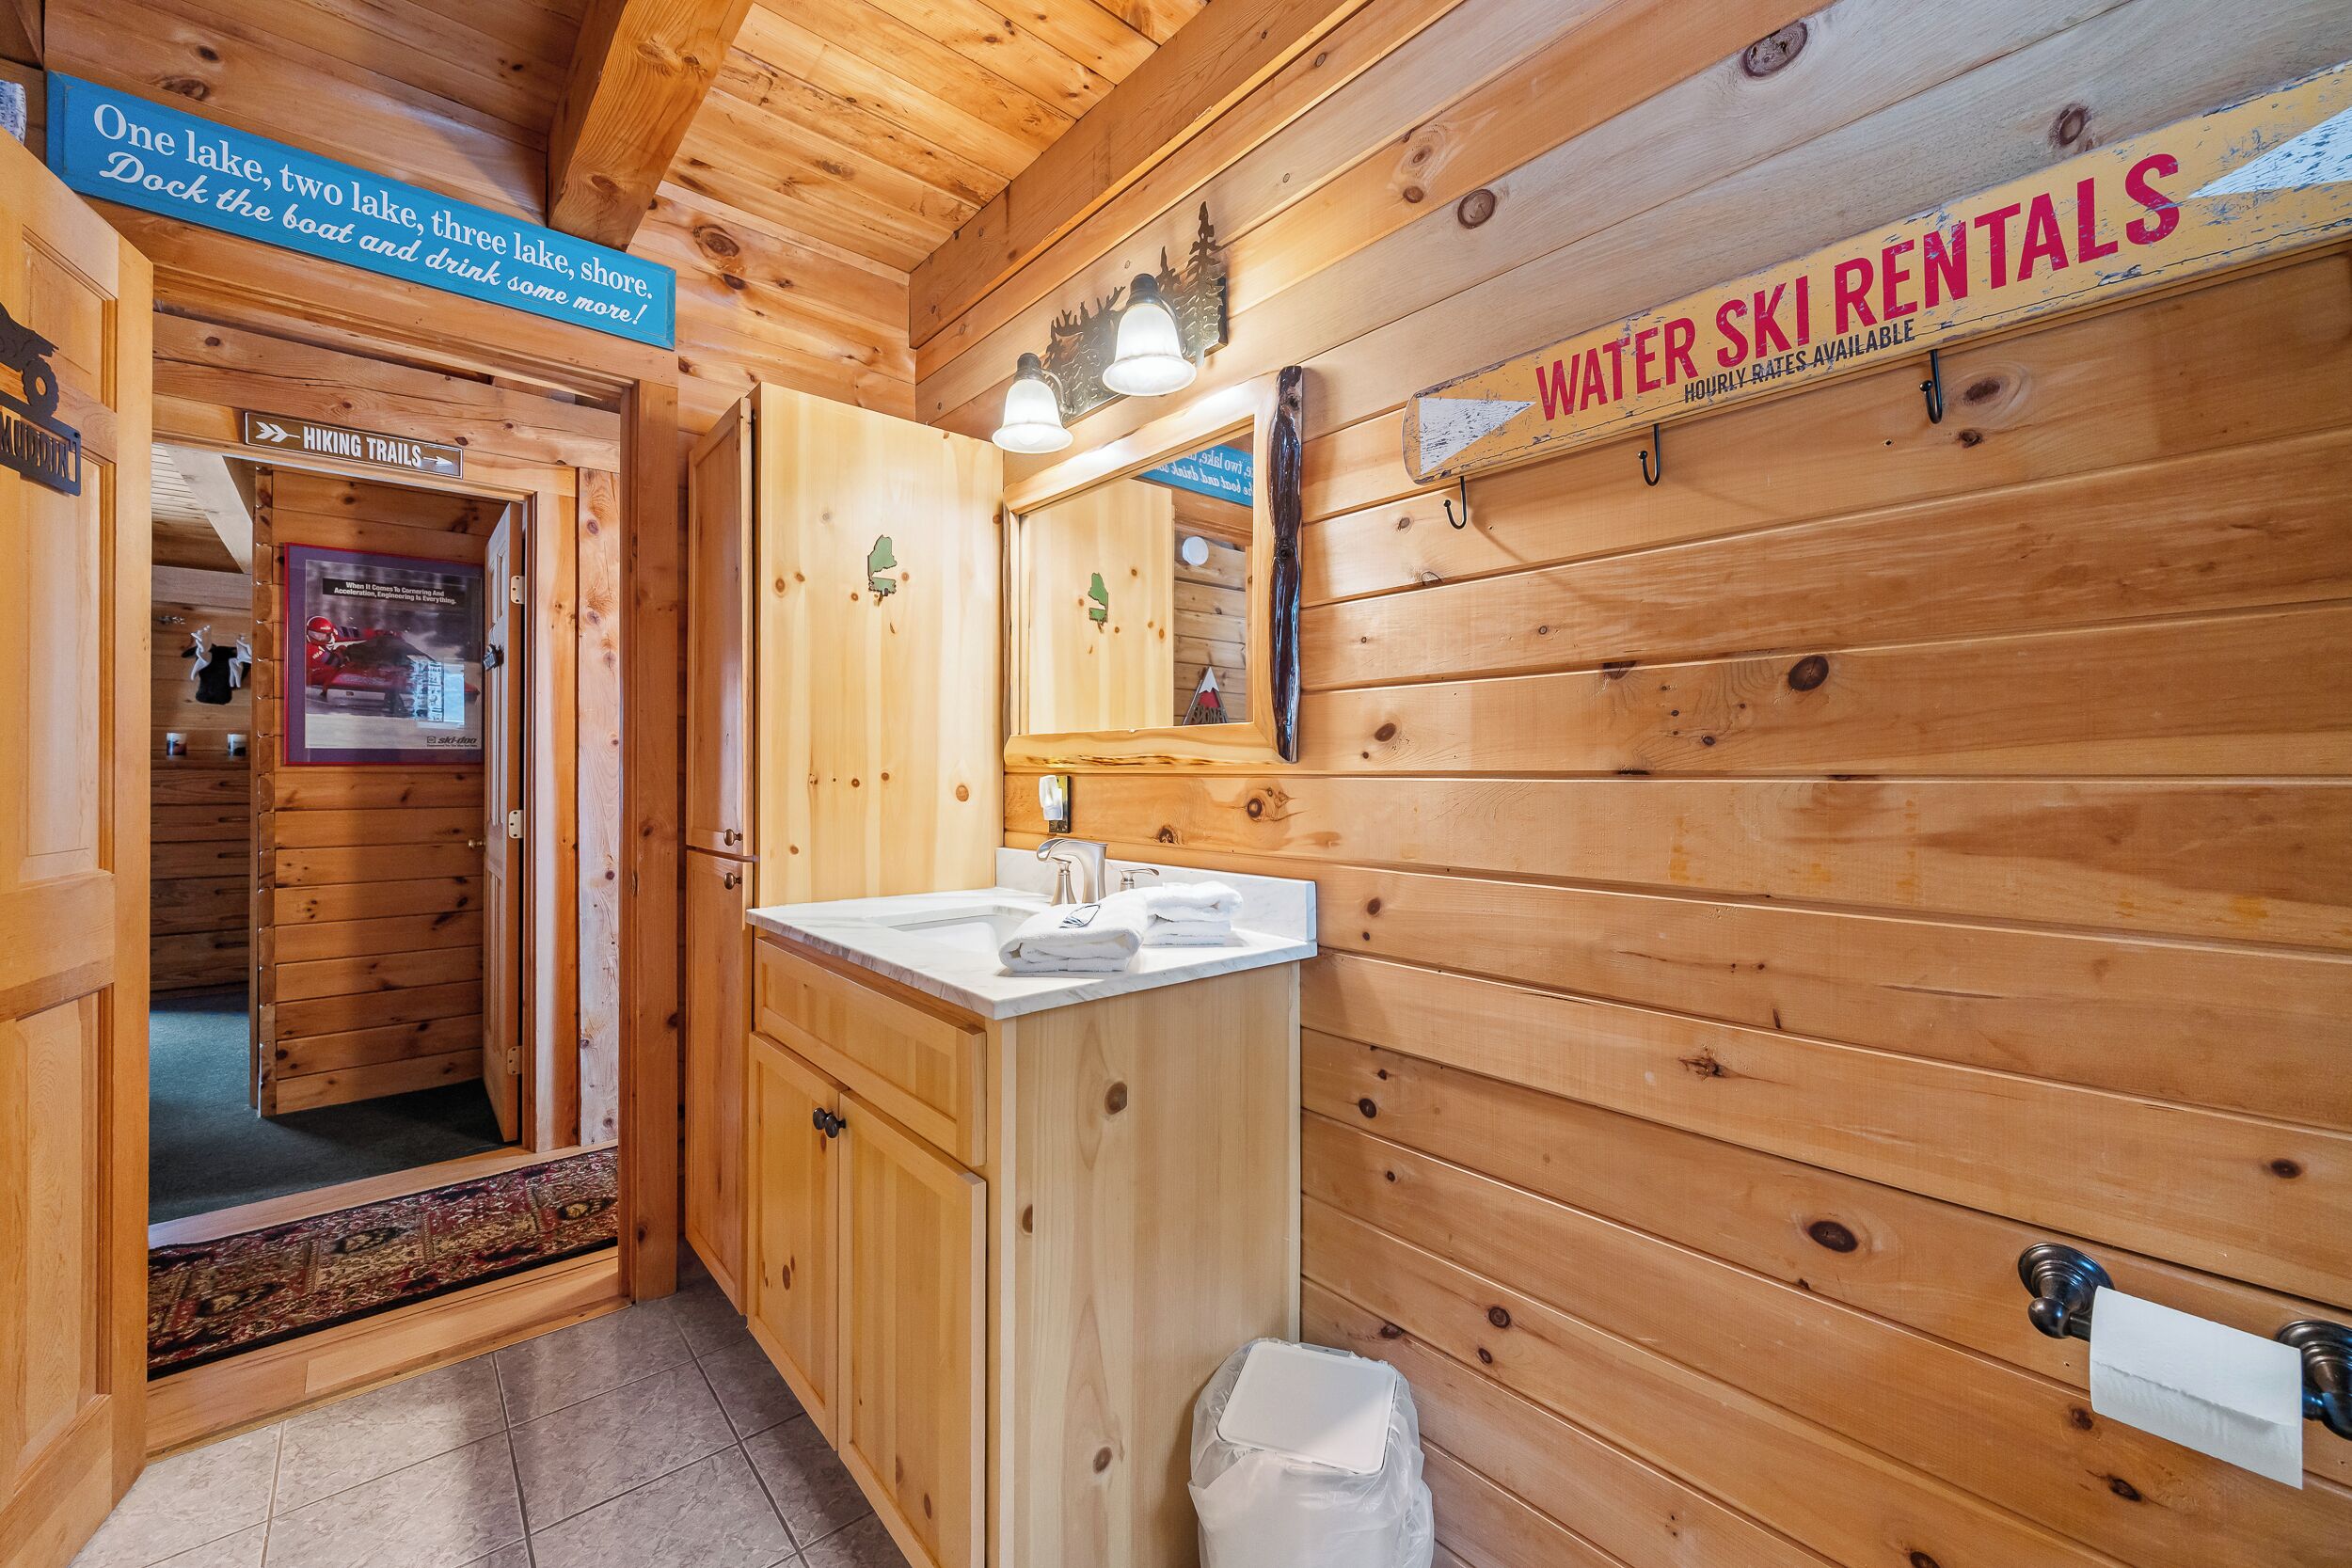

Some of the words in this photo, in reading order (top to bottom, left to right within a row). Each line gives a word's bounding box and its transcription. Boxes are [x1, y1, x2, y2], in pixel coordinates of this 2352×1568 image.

[93, 103, 175, 156] One
[185, 130, 272, 191] lake,
[278, 164, 343, 206] two
[351, 181, 425, 237] lake,
[431, 210, 507, 255] three
[514, 231, 575, 281] lake,
[580, 257, 653, 299] shore.
[99, 151, 209, 204] Dock
[216, 189, 274, 222] the
[283, 203, 356, 244] boat
[359, 236, 420, 262] and
[425, 247, 501, 286] drink
[507, 276, 569, 305] some
[572, 295, 648, 325] more!
[1535, 317, 1699, 420] WATER
[1715, 275, 1810, 368] SKI
[1834, 153, 2180, 336] RENTALS
[1684, 367, 1747, 404] HOURLY
[1752, 350, 1807, 385] RATES
[1812, 318, 1915, 368] AVAILABLE
[303, 426, 362, 458] HIKING
[366, 436, 422, 468] TRAILS
[333, 587, 377, 598] Acceleration,
[377, 591, 415, 601] Engineering
[422, 595, 457, 605] Everything.
[345, 581, 365, 590] When
[401, 587, 432, 596] Cornering
[437, 736, 478, 744] ski-doo
